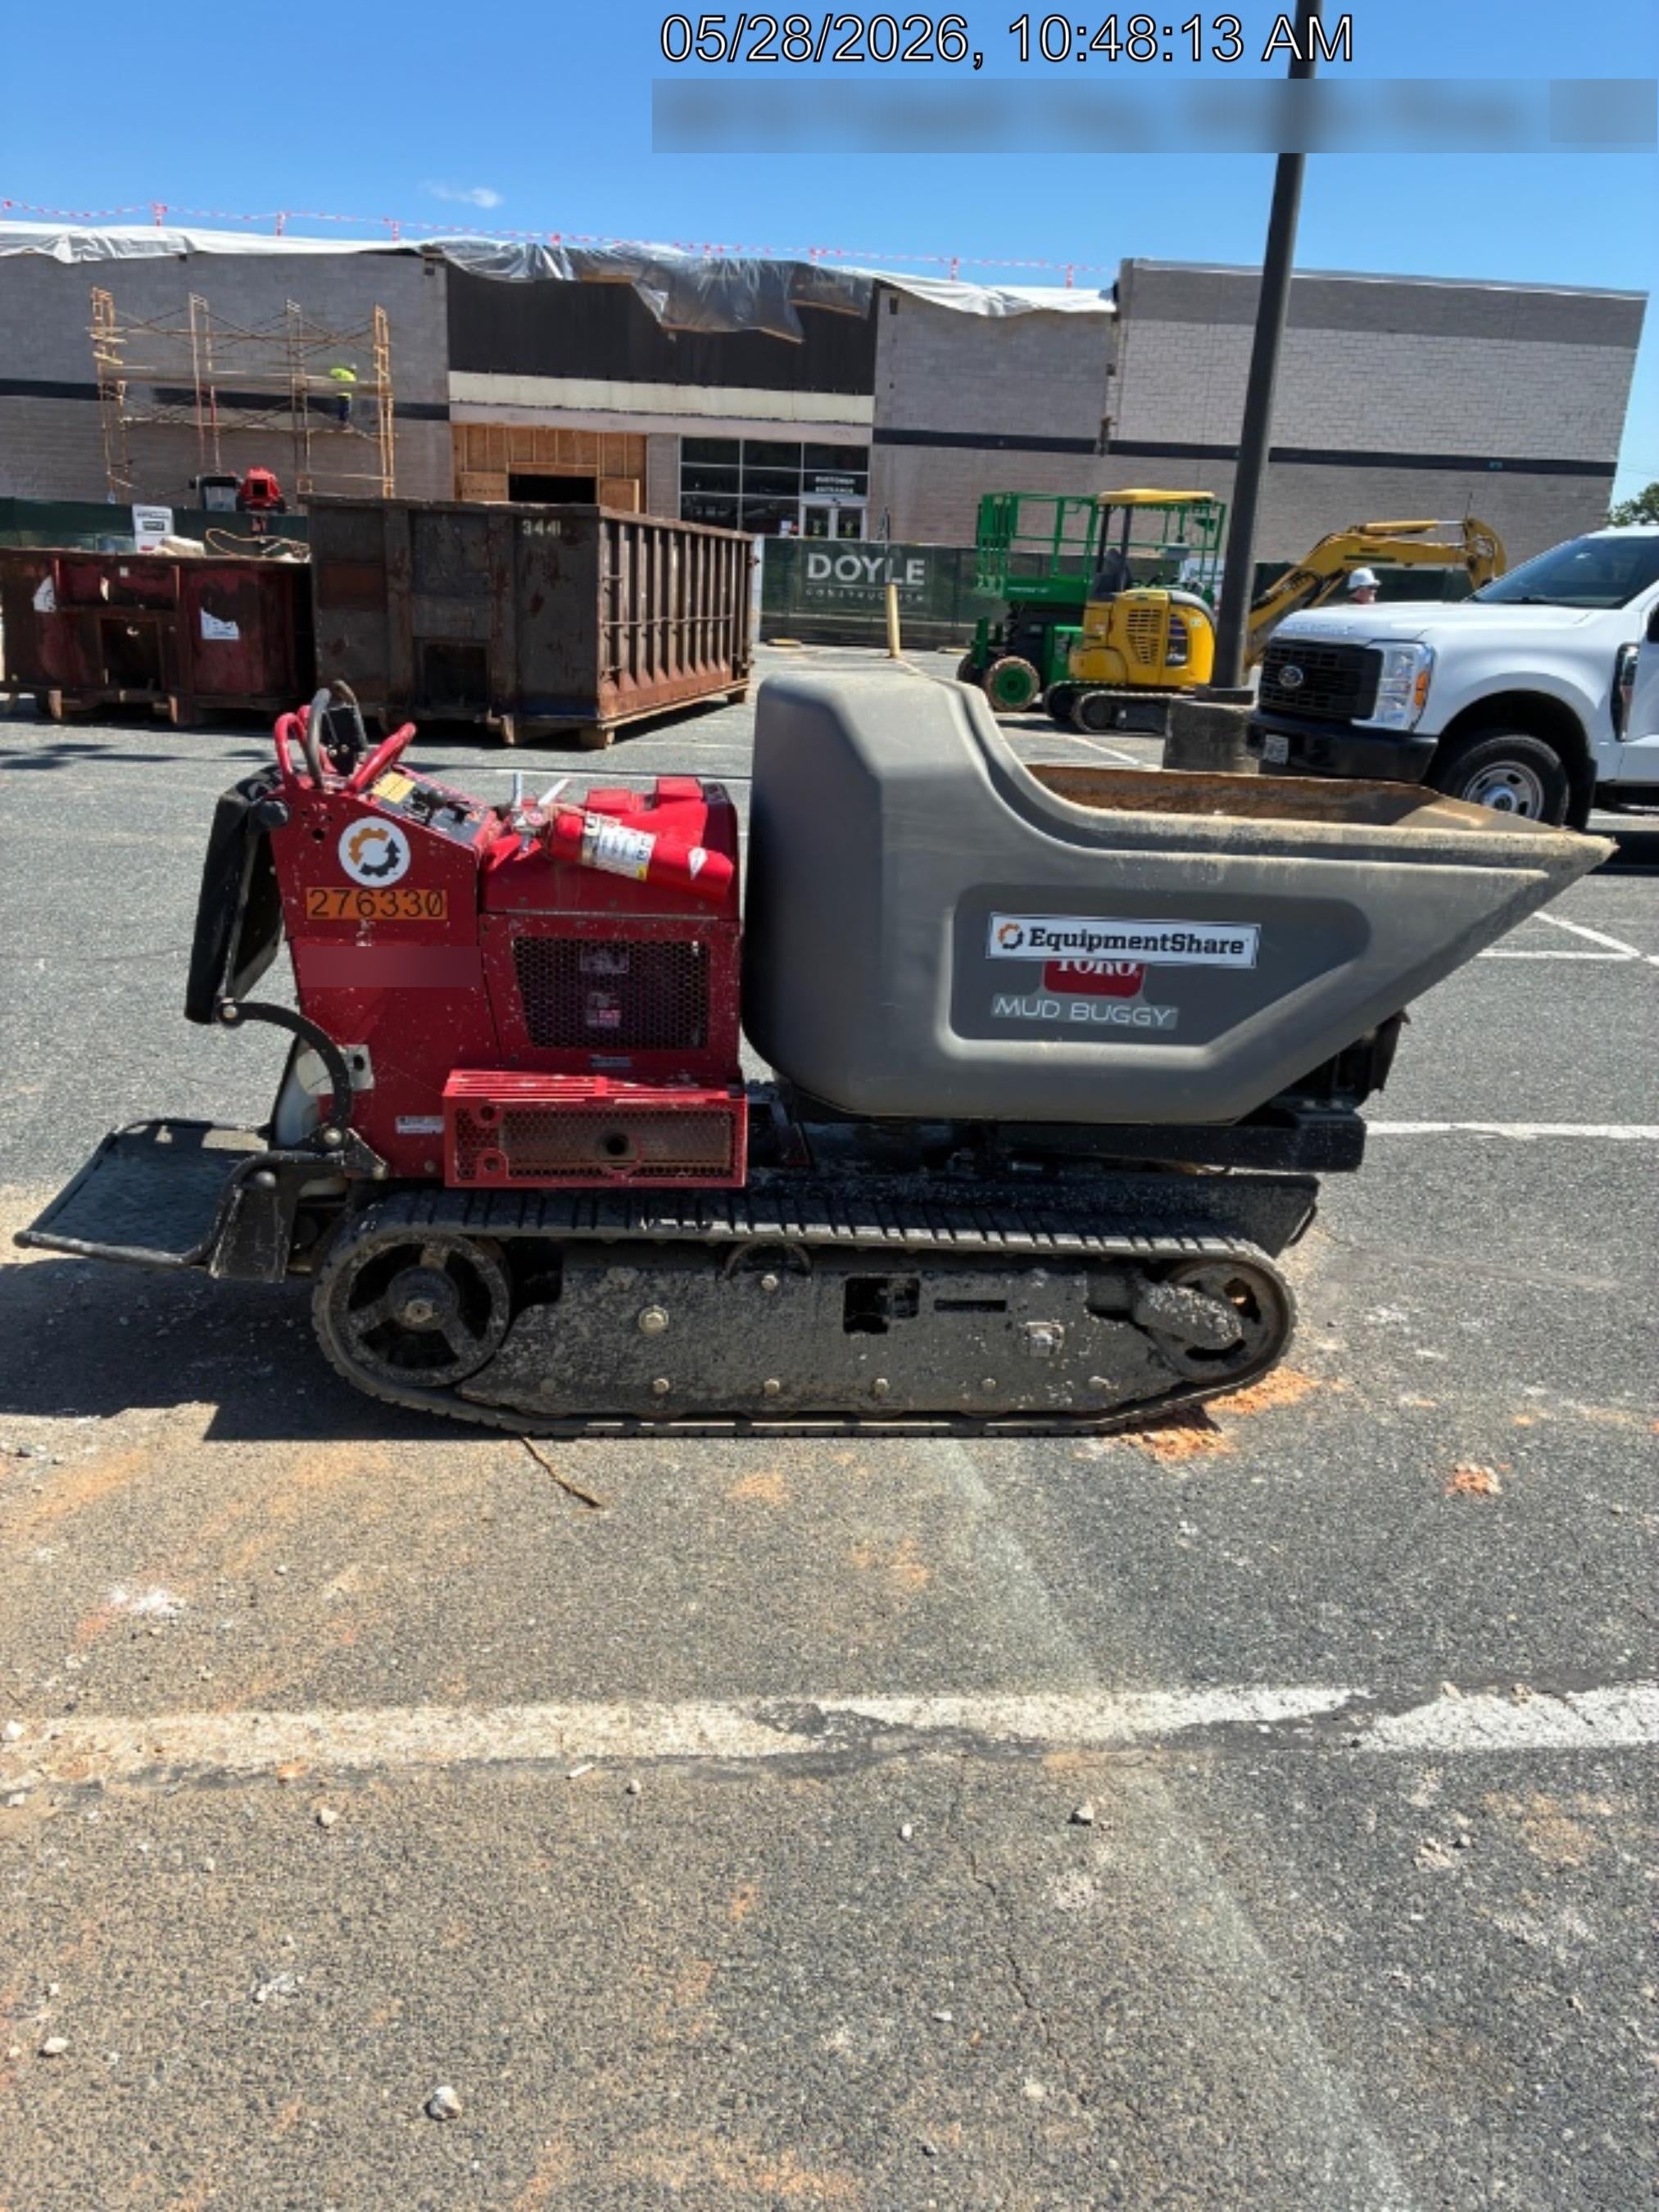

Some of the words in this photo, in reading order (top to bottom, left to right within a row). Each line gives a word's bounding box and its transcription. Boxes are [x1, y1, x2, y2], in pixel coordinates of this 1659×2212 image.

[807, 552, 926, 587] DOYLE
[805, 589, 925, 602] CONSTRUCION
[309, 889, 444, 918] 276330
[1028, 926, 1244, 954] EquipmentShare
[995, 996, 1061, 1018] MUD
[1070, 1002, 1172, 1027] BUGGY
